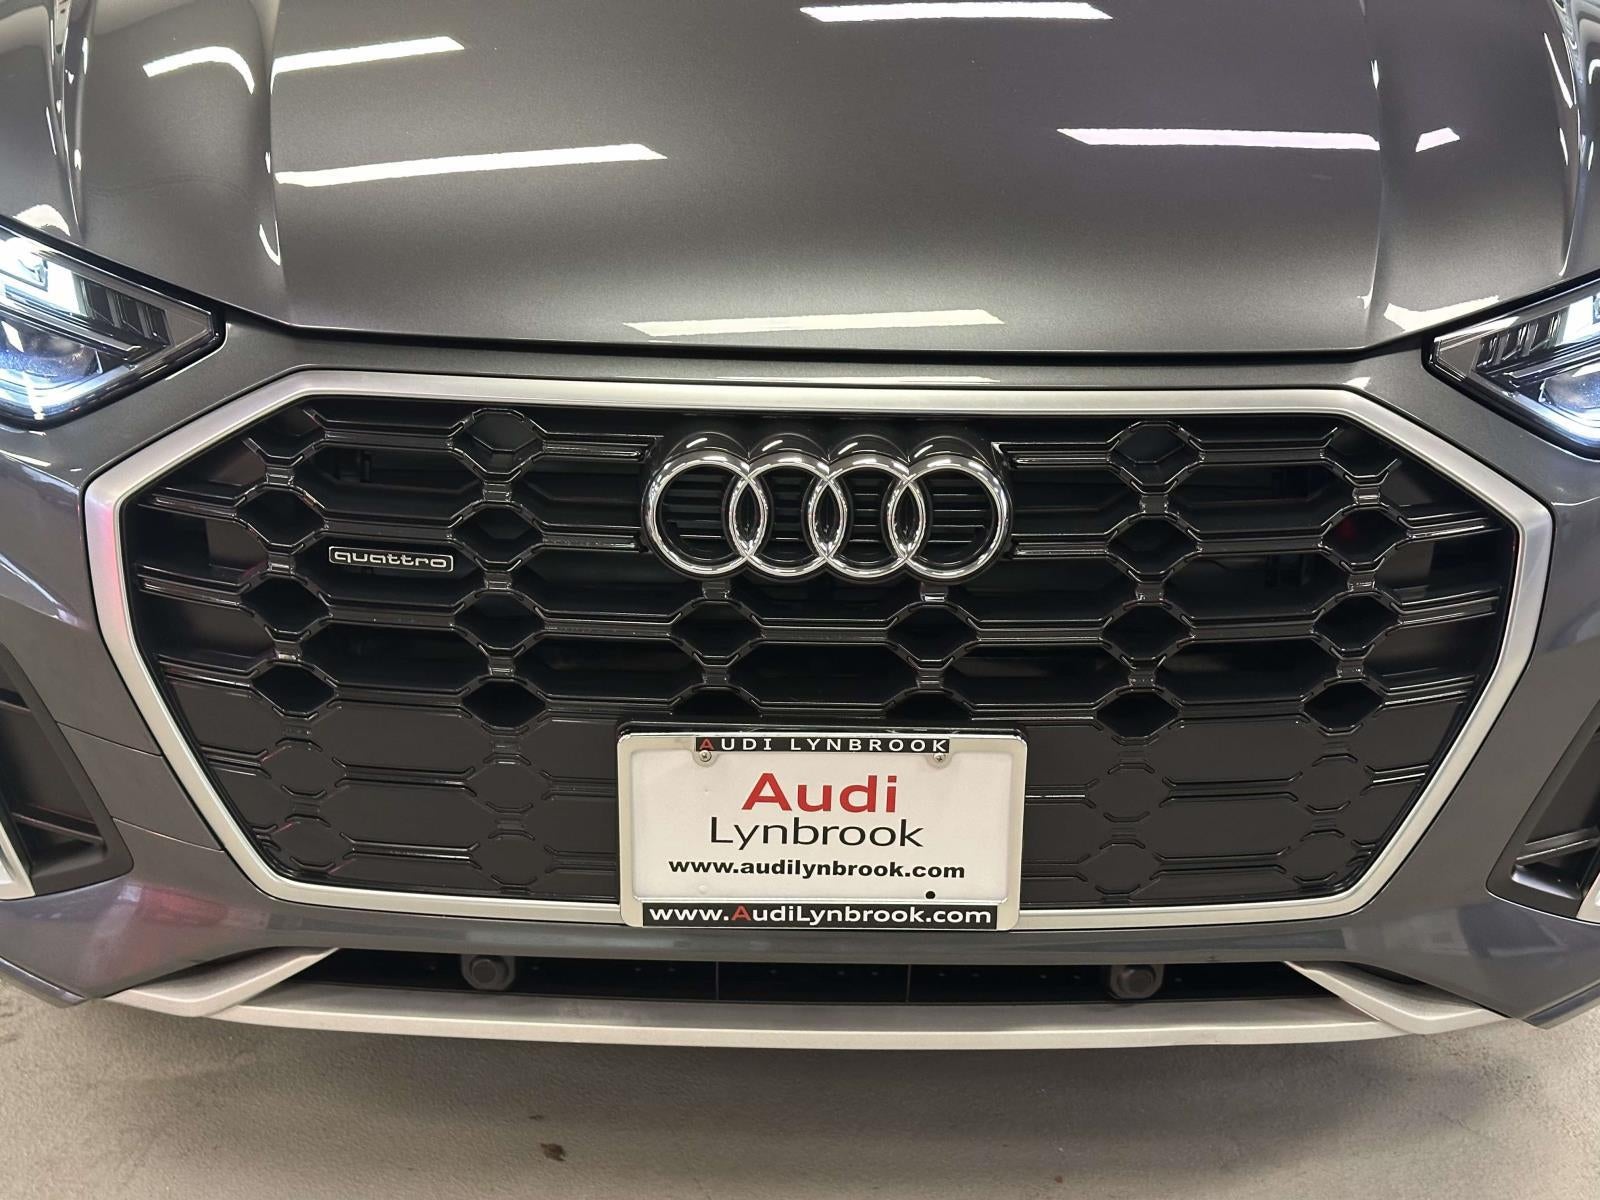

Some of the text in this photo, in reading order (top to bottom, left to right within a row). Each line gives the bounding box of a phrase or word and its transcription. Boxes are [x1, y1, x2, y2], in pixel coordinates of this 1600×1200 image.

[334, 551, 447, 568] quattro
[700, 738, 948, 753] AUDI LYNBROOK
[741, 772, 897, 813] Audi
[710, 816, 924, 850] Lynbrook
[669, 859, 965, 880] www.audilynbrook.com
[649, 905, 992, 926] www.AudiLynbrook.com
